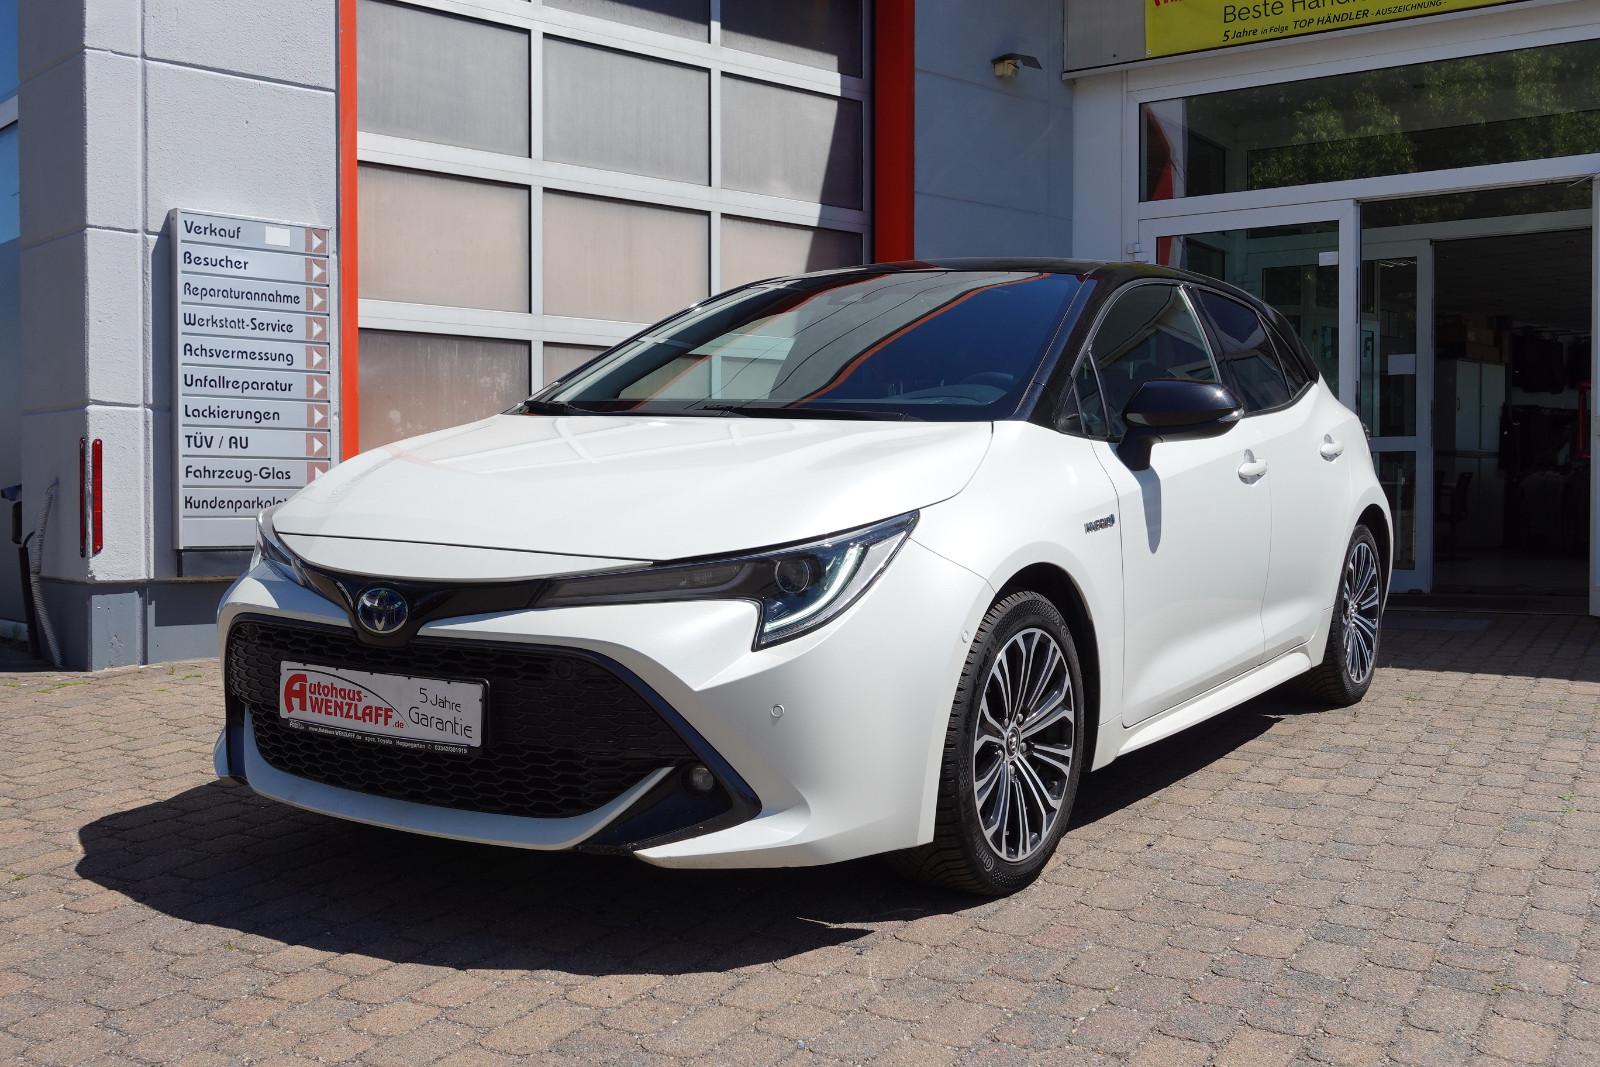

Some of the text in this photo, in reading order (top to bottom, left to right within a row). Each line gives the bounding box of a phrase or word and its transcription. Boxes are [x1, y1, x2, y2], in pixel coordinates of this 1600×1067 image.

[1222, 30, 1230, 42] 5
[1231, 28, 1258, 40] Jahre
[1261, 27, 1268, 35] in
[1269, 25, 1289, 34] Folge
[1293, 19, 1314, 29] TOP
[1317, 9, 1369, 26] HÄNDLER
[1375, 0, 1442, 16] AUSZEICHNUNG
[1223, 0, 1284, 23] Beste
[184, 220, 241, 240] Verkauf
[184, 251, 249, 270] Besucher
[184, 282, 301, 305] Reparaturannahme
[183, 313, 294, 333] Werkstatt-Service
[184, 343, 294, 366] Achsvermessung
[184, 374, 293, 393] Unfallreparatur
[184, 404, 280, 423] Lackierungen
[185, 432, 249, 449] TÜV / AU
[185, 465, 291, 483] Fahrzeug-Glas
[419, 688, 462, 713] 5 Jahre
[408, 706, 473, 739] Garantie
